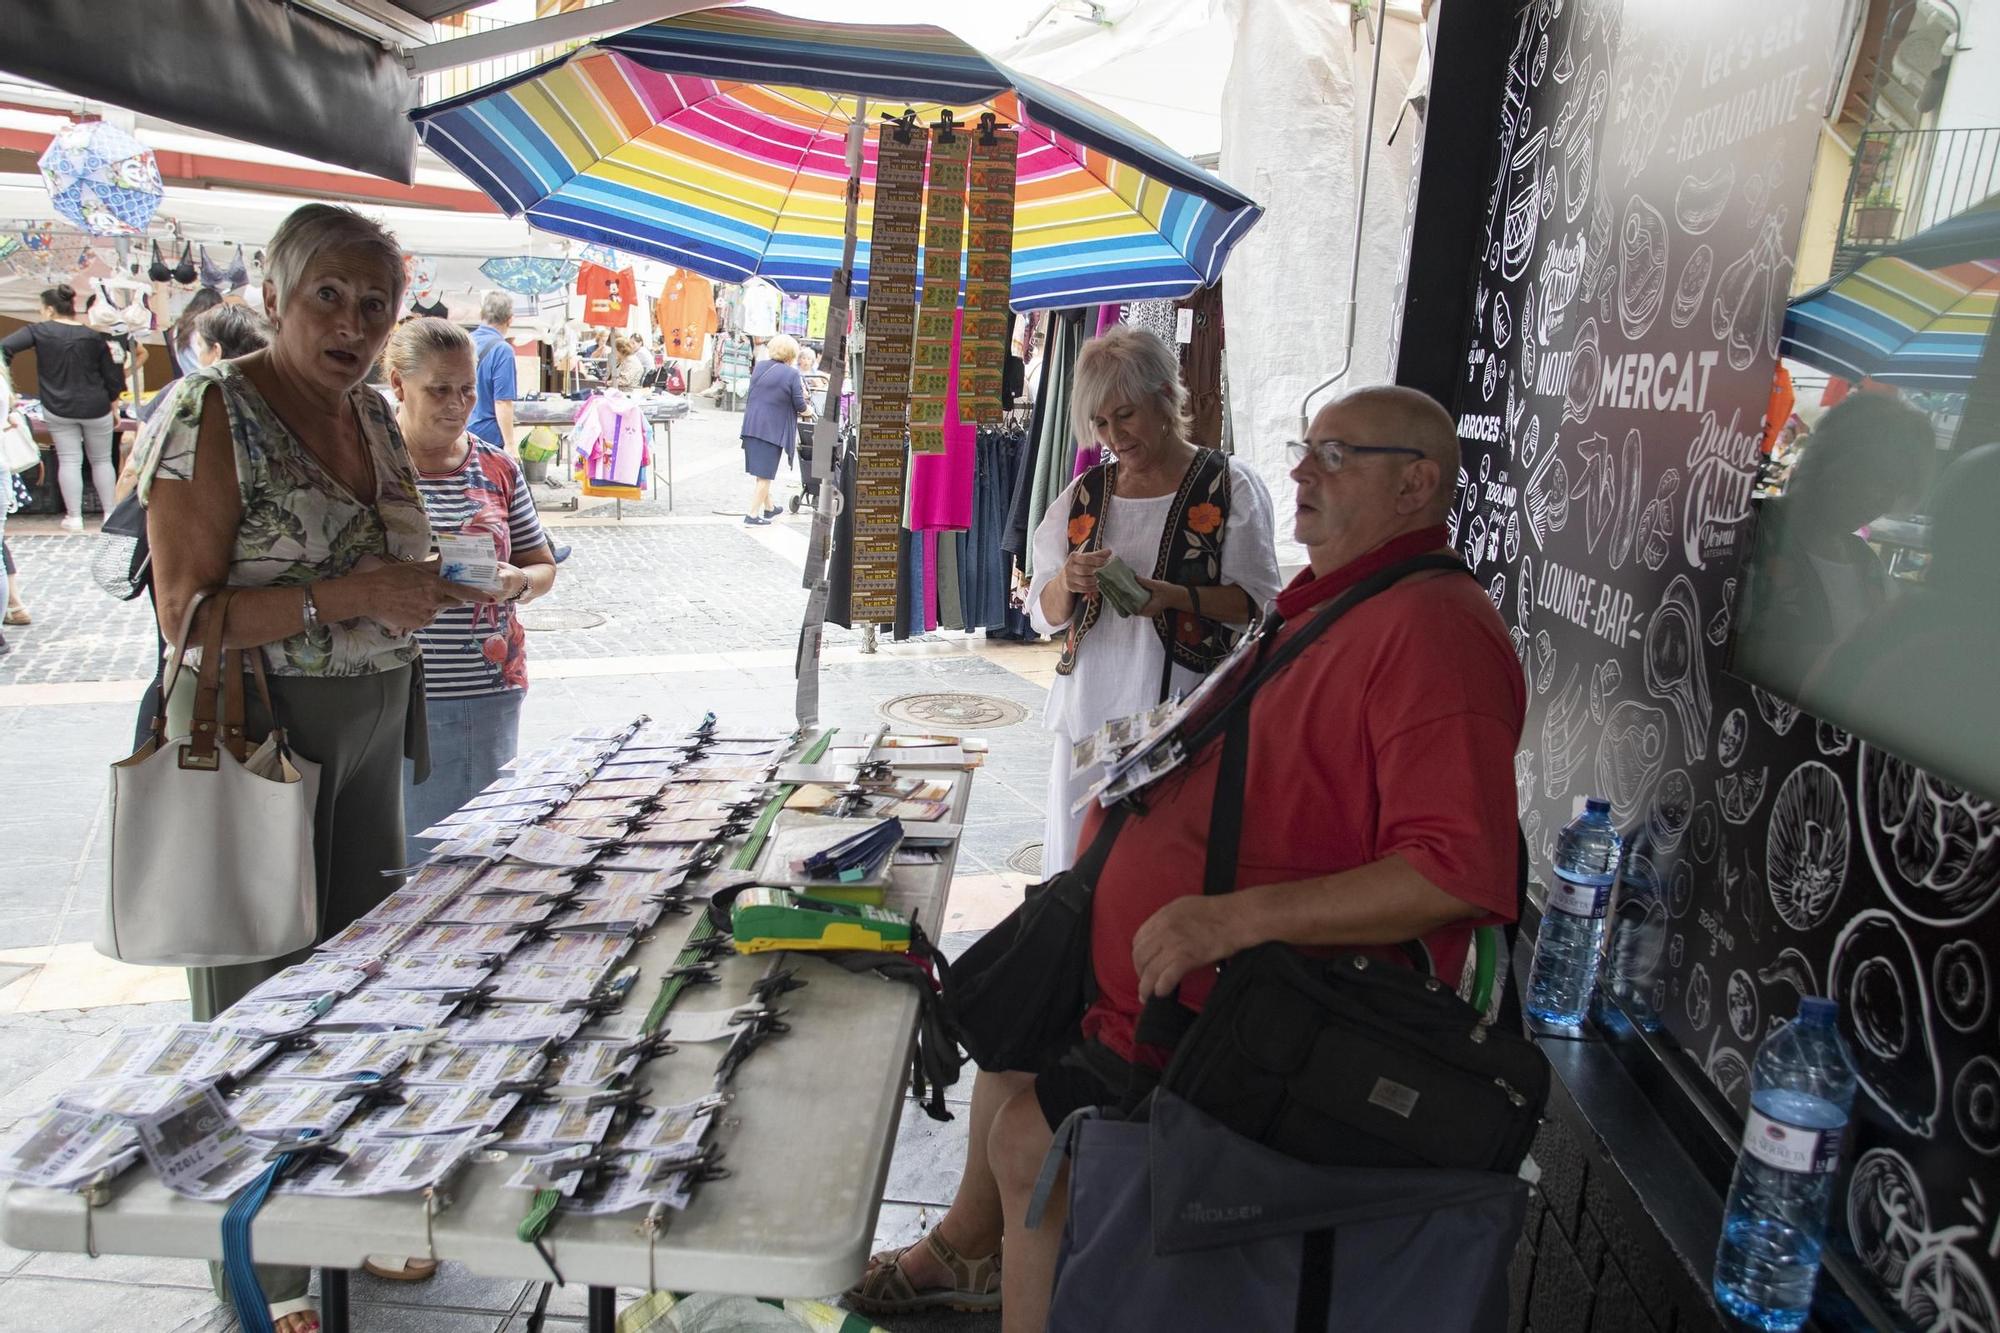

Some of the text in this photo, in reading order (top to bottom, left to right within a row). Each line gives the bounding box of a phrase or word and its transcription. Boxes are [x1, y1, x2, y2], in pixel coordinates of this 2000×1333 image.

[1676, 65, 1809, 164] RESTAURANTE
[1536, 351, 1572, 397] MOJIT
[1598, 350, 1719, 413] MERCAT
[1456, 413, 1500, 443] ARROCES
[1537, 560, 1633, 649] LOUNGE-BAR
